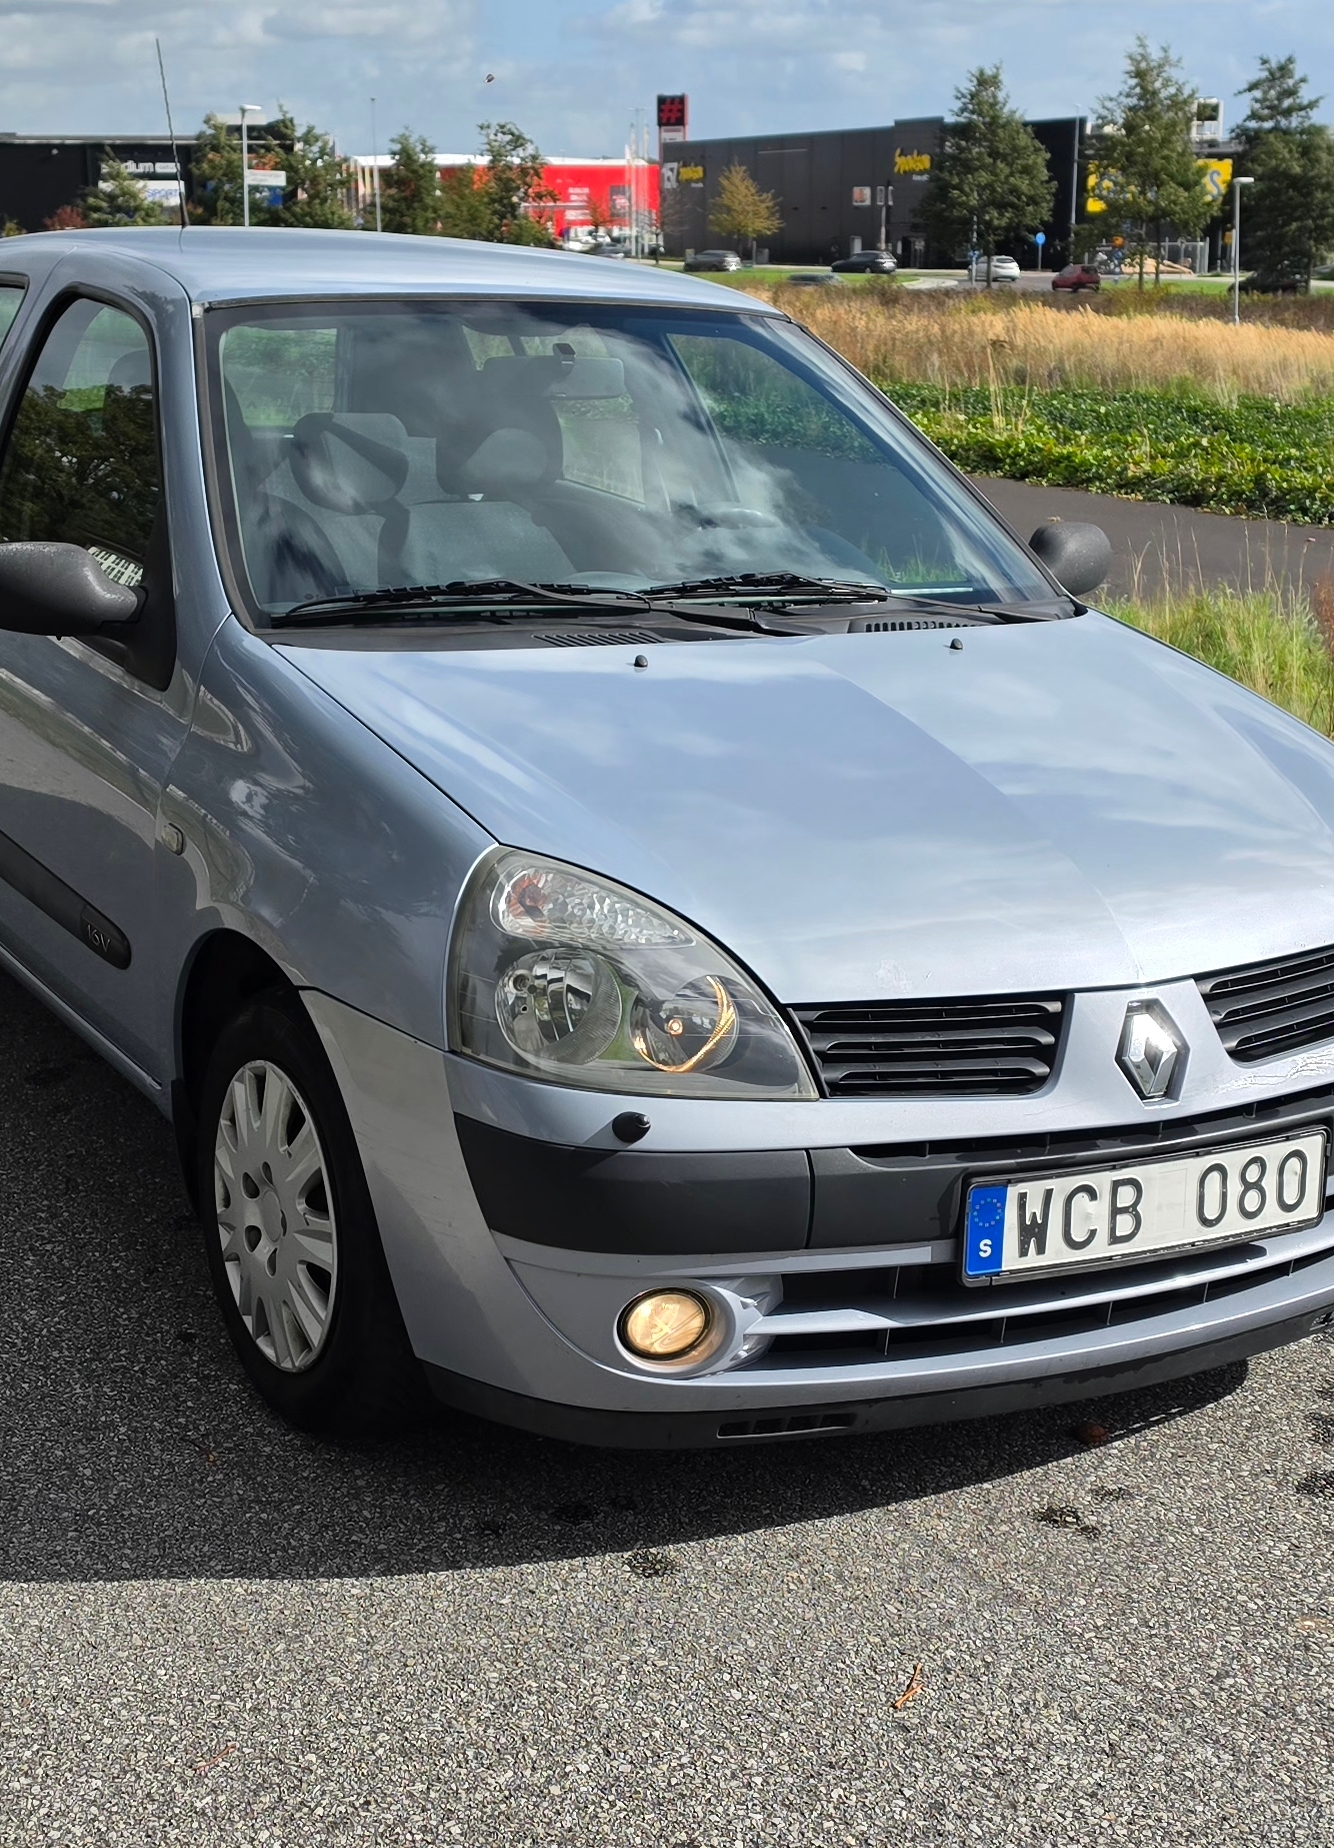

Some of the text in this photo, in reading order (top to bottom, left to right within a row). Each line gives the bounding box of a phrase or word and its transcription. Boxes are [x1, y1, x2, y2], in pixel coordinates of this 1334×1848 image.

[87, 924, 111, 952] 16V
[978, 1149, 1308, 1258] S WCB 080
